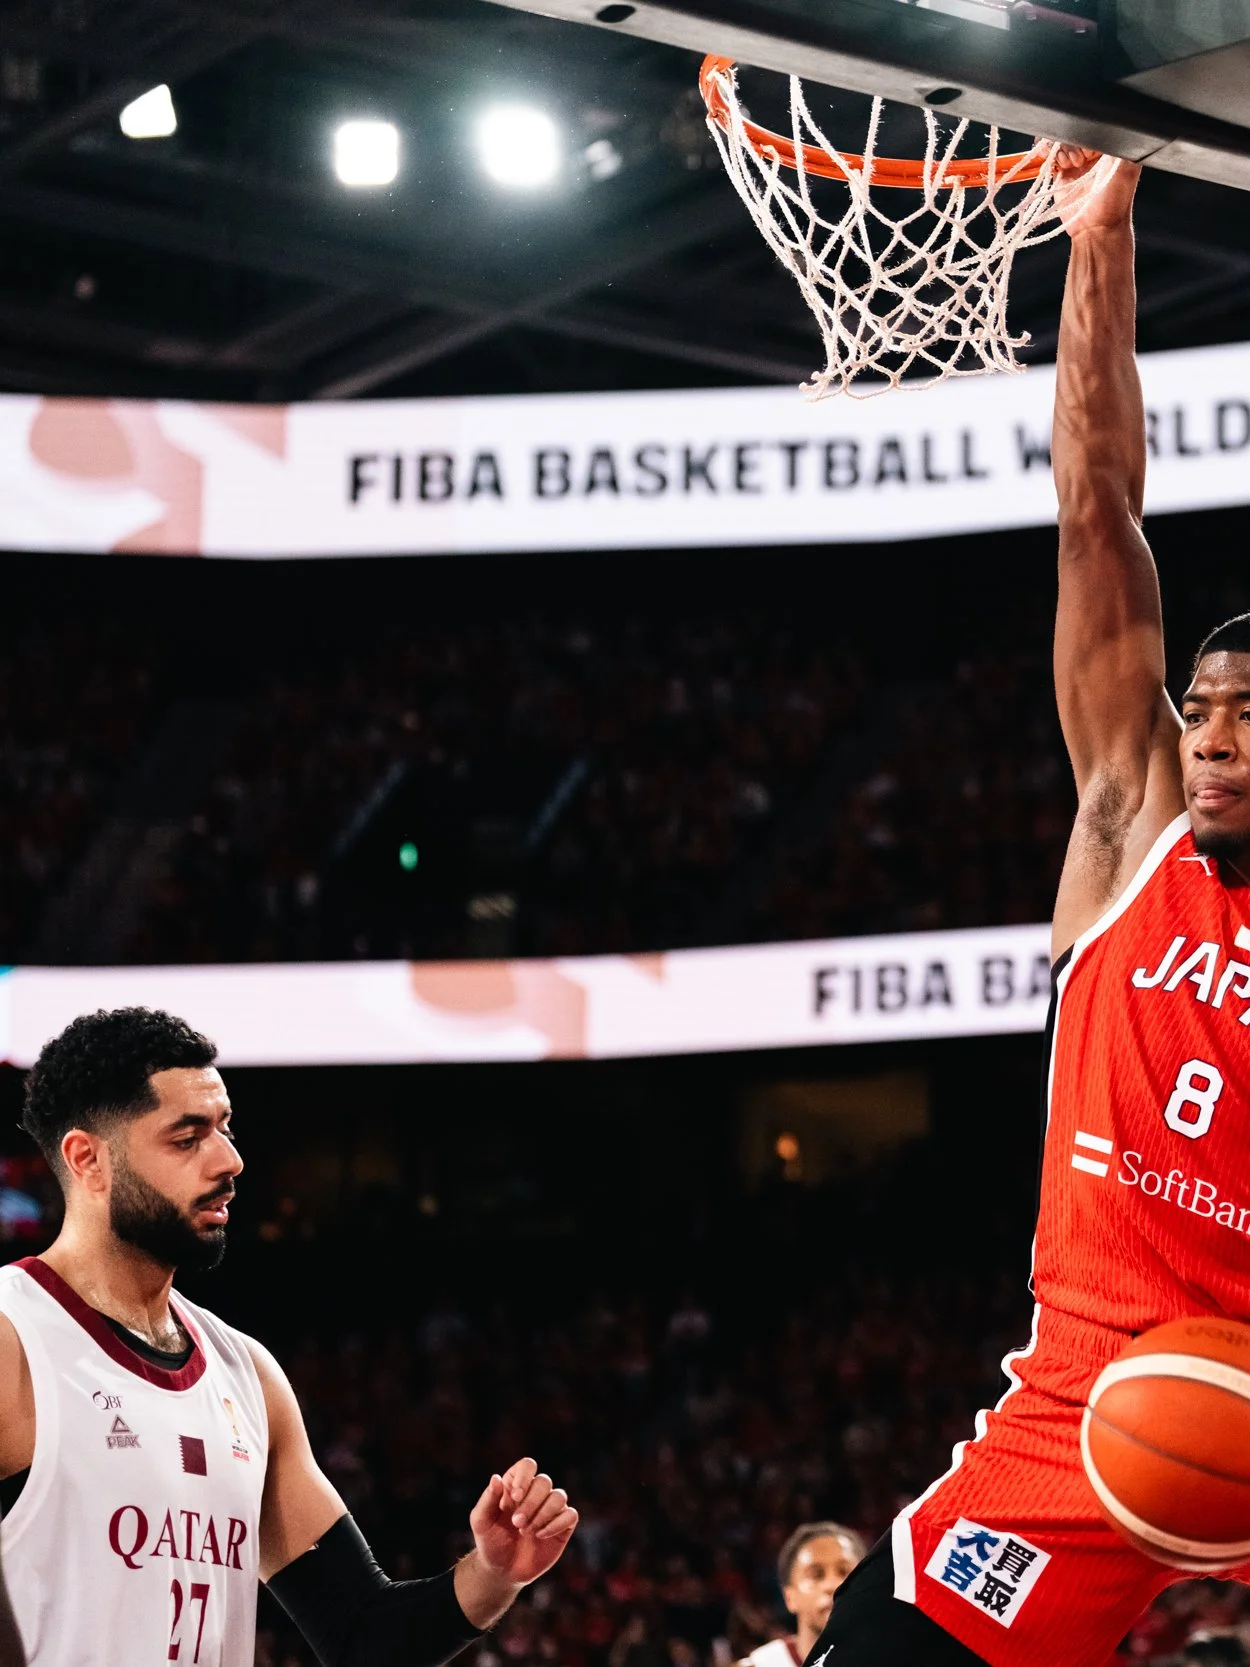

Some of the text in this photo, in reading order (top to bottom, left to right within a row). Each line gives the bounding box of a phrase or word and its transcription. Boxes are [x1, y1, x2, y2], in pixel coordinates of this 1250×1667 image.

[350, 451, 504, 505] FIBA
[534, 428, 989, 499] BASKETBALL
[813, 960, 952, 1016] FIBA
[1163, 1058, 1224, 1140] 8
[92, 1391, 123, 1411] QBF
[105, 1434, 142, 1450] PEAK
[109, 1505, 247, 1570] QATAR
[974, 1538, 1038, 1617] 買取
[168, 1579, 210, 1664] 27
